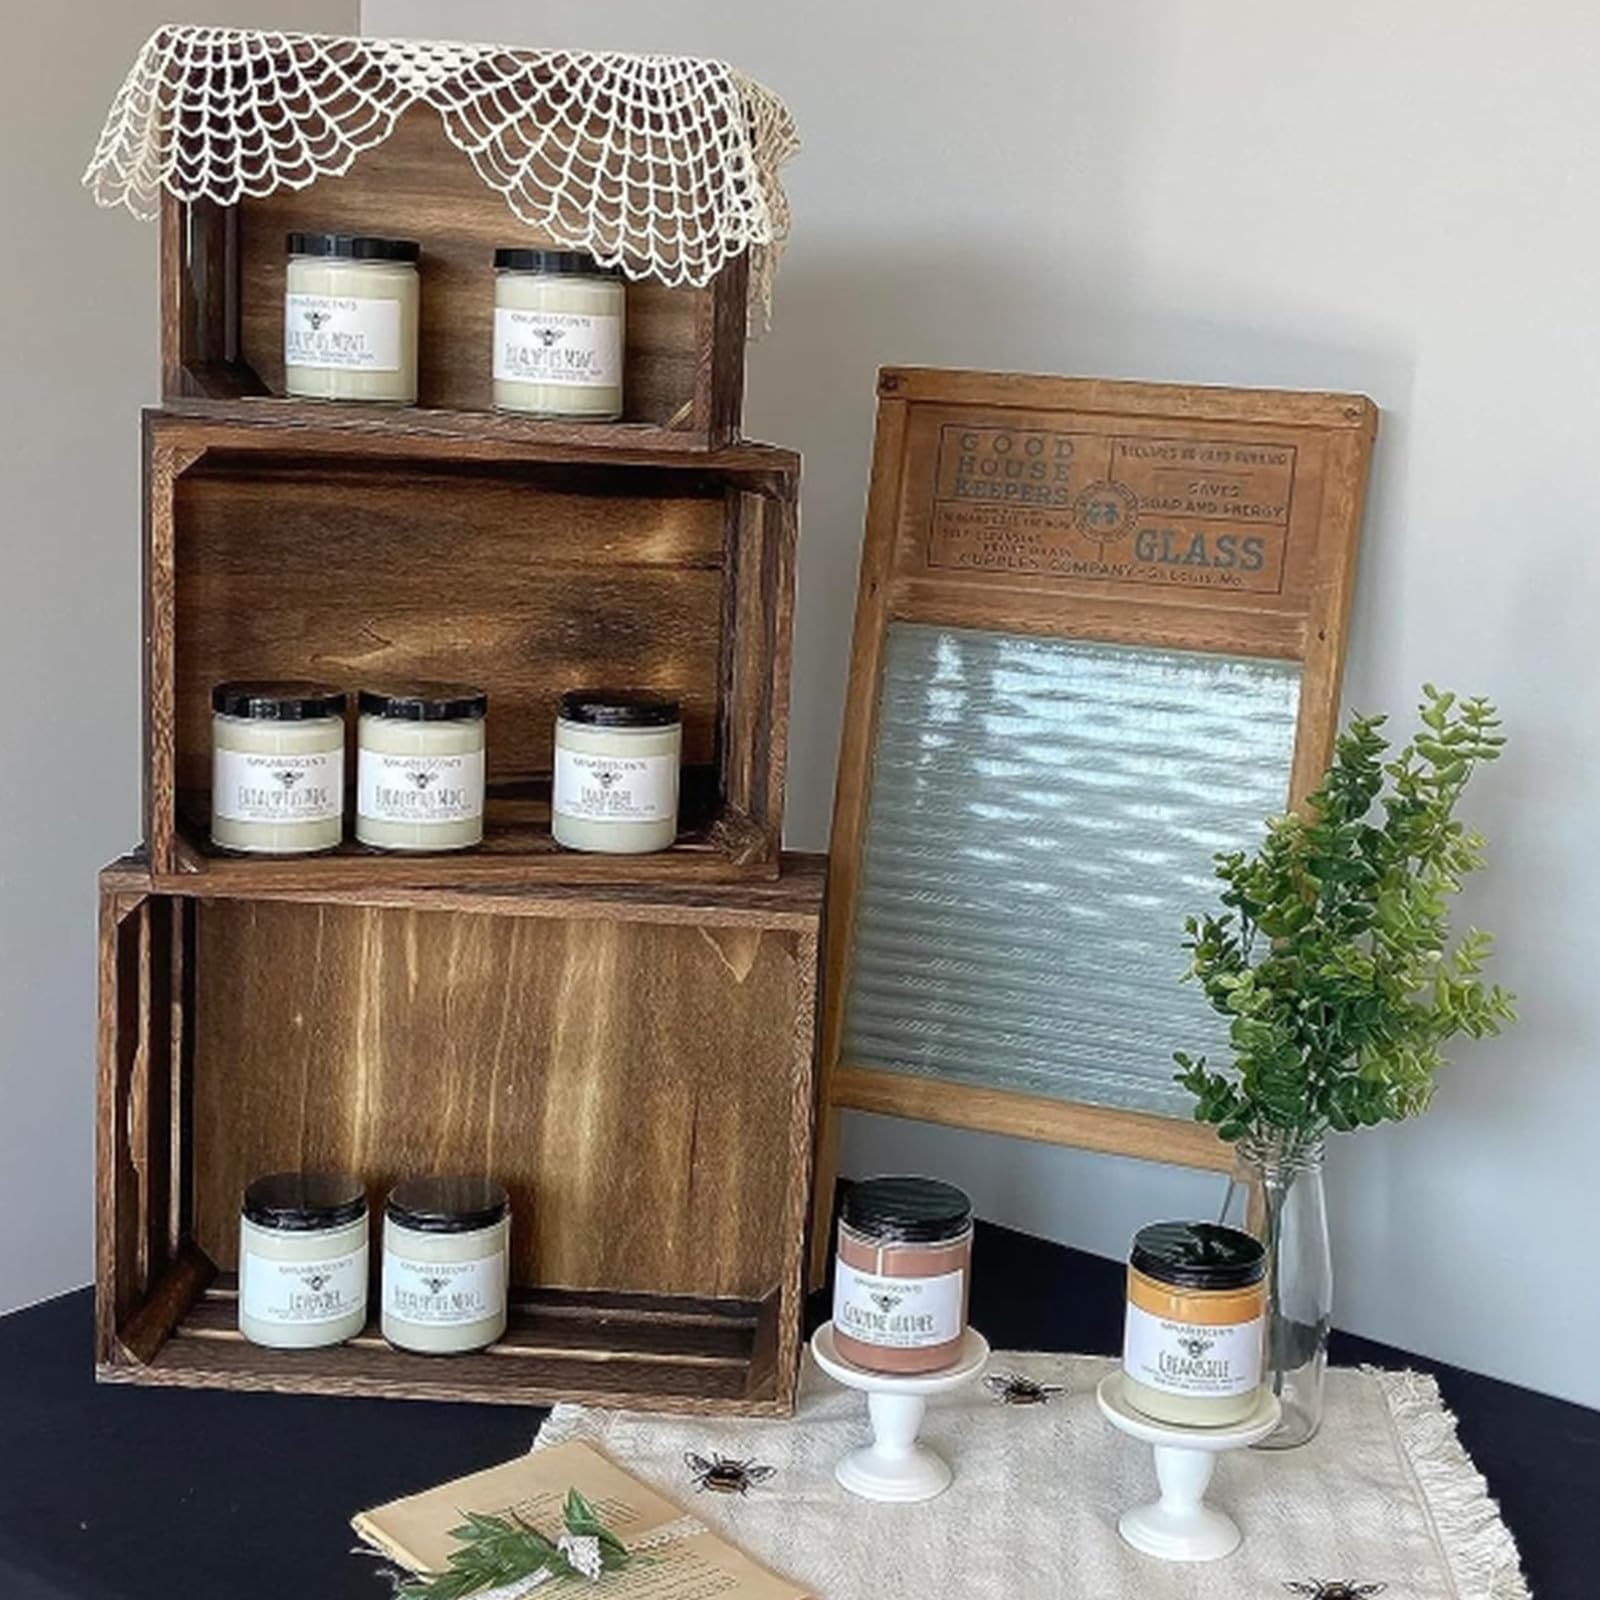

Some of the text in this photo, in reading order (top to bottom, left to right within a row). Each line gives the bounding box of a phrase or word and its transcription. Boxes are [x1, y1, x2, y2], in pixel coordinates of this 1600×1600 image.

[960, 433, 1074, 458] GOOD
[957, 456, 1070, 482] HOUSE
[955, 479, 1070, 505] KEEPERS
[1187, 482, 1241, 498] SAVES
[1186, 502, 1218, 514] AND
[1135, 528, 1264, 571] GLASS
[1050, 559, 1132, 577] COMPANY
